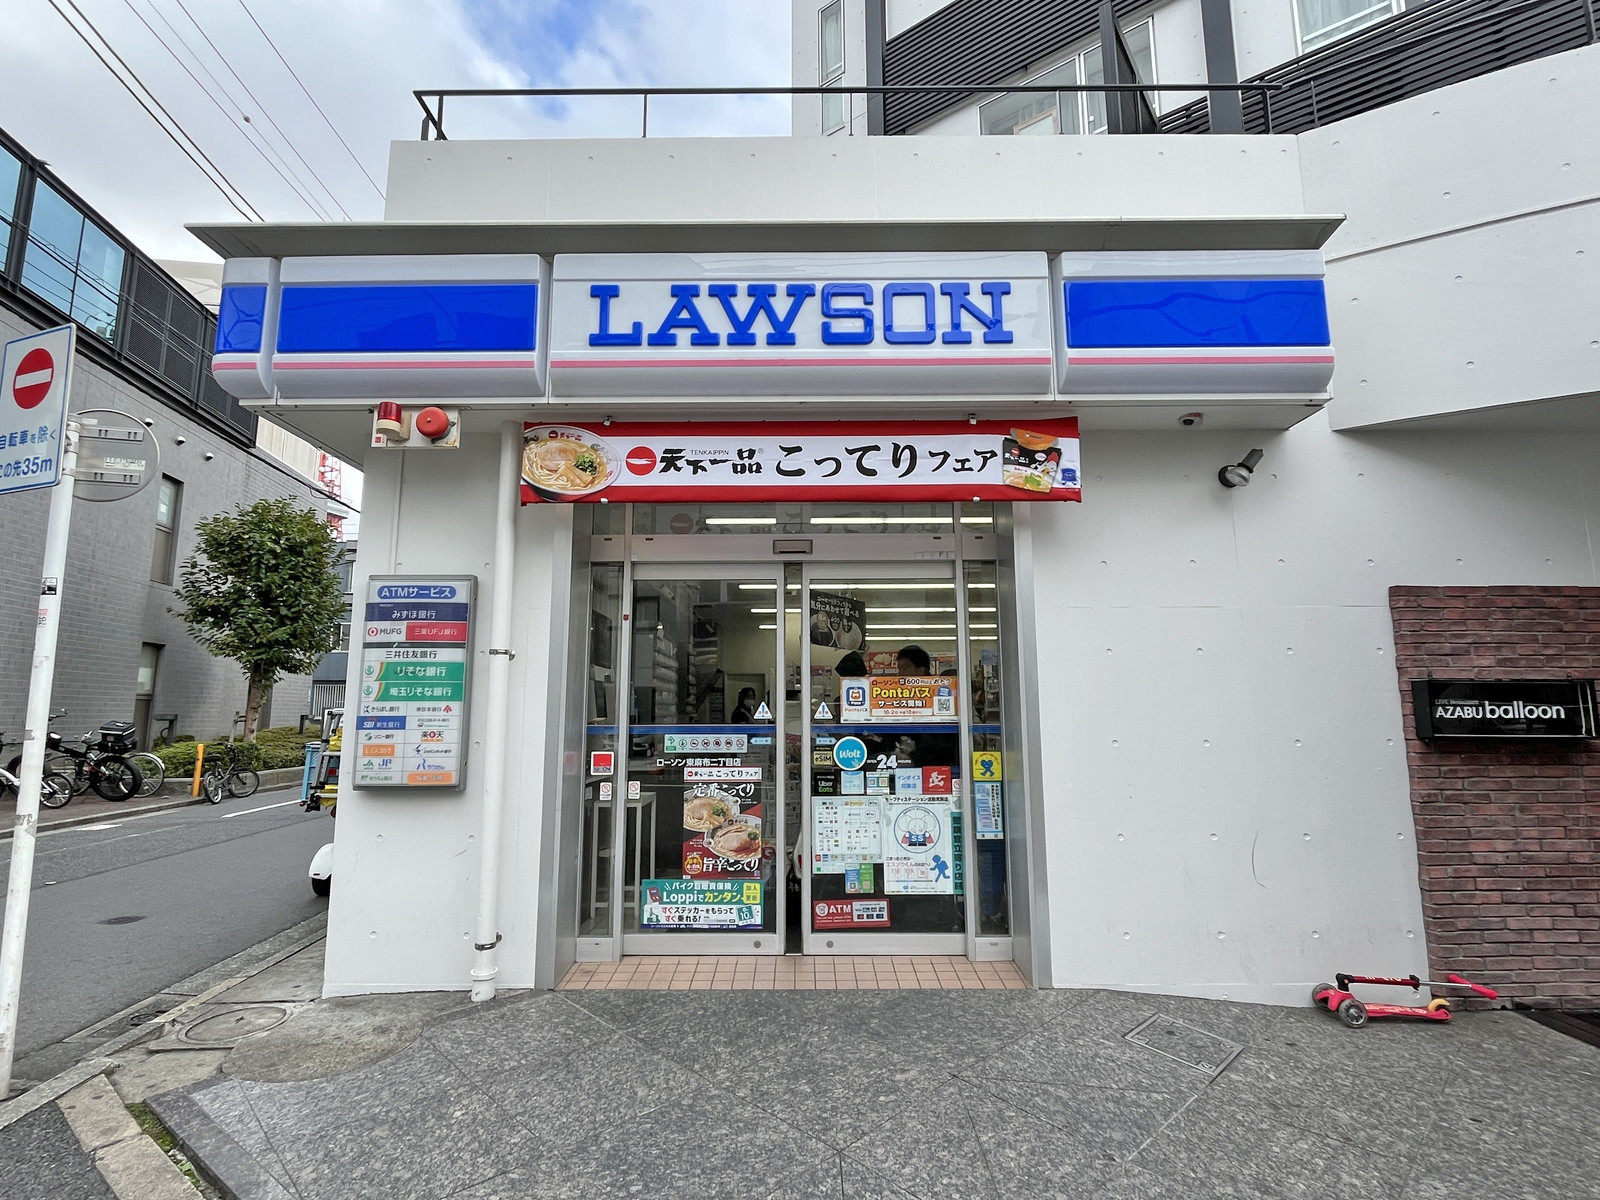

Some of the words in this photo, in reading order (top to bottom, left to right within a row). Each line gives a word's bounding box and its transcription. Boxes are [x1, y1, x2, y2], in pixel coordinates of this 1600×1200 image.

[588, 281, 1013, 346] LAWSON
[775, 442, 998, 478] こってりフェア
[381, 587, 451, 597] ATMサービス
[392, 610, 436, 619] みずほ銀行
[385, 650, 438, 659] 三井住友銀行
[397, 666, 447, 676] りそな銀行
[389, 687, 452, 697] 埼玉りそな銀行
[872, 687, 931, 698] Pontaパス
[1435, 706, 1483, 718] AZABU
[1485, 700, 1566, 719] balloon
[839, 749, 861, 758] Wolt
[876, 754, 898, 768] 24
[692, 783, 754, 797] 定番こってり
[703, 857, 759, 872] 旨辛こってり
[661, 906, 734, 915] すぐステッカーをもらって
[829, 904, 851, 913] ATM
